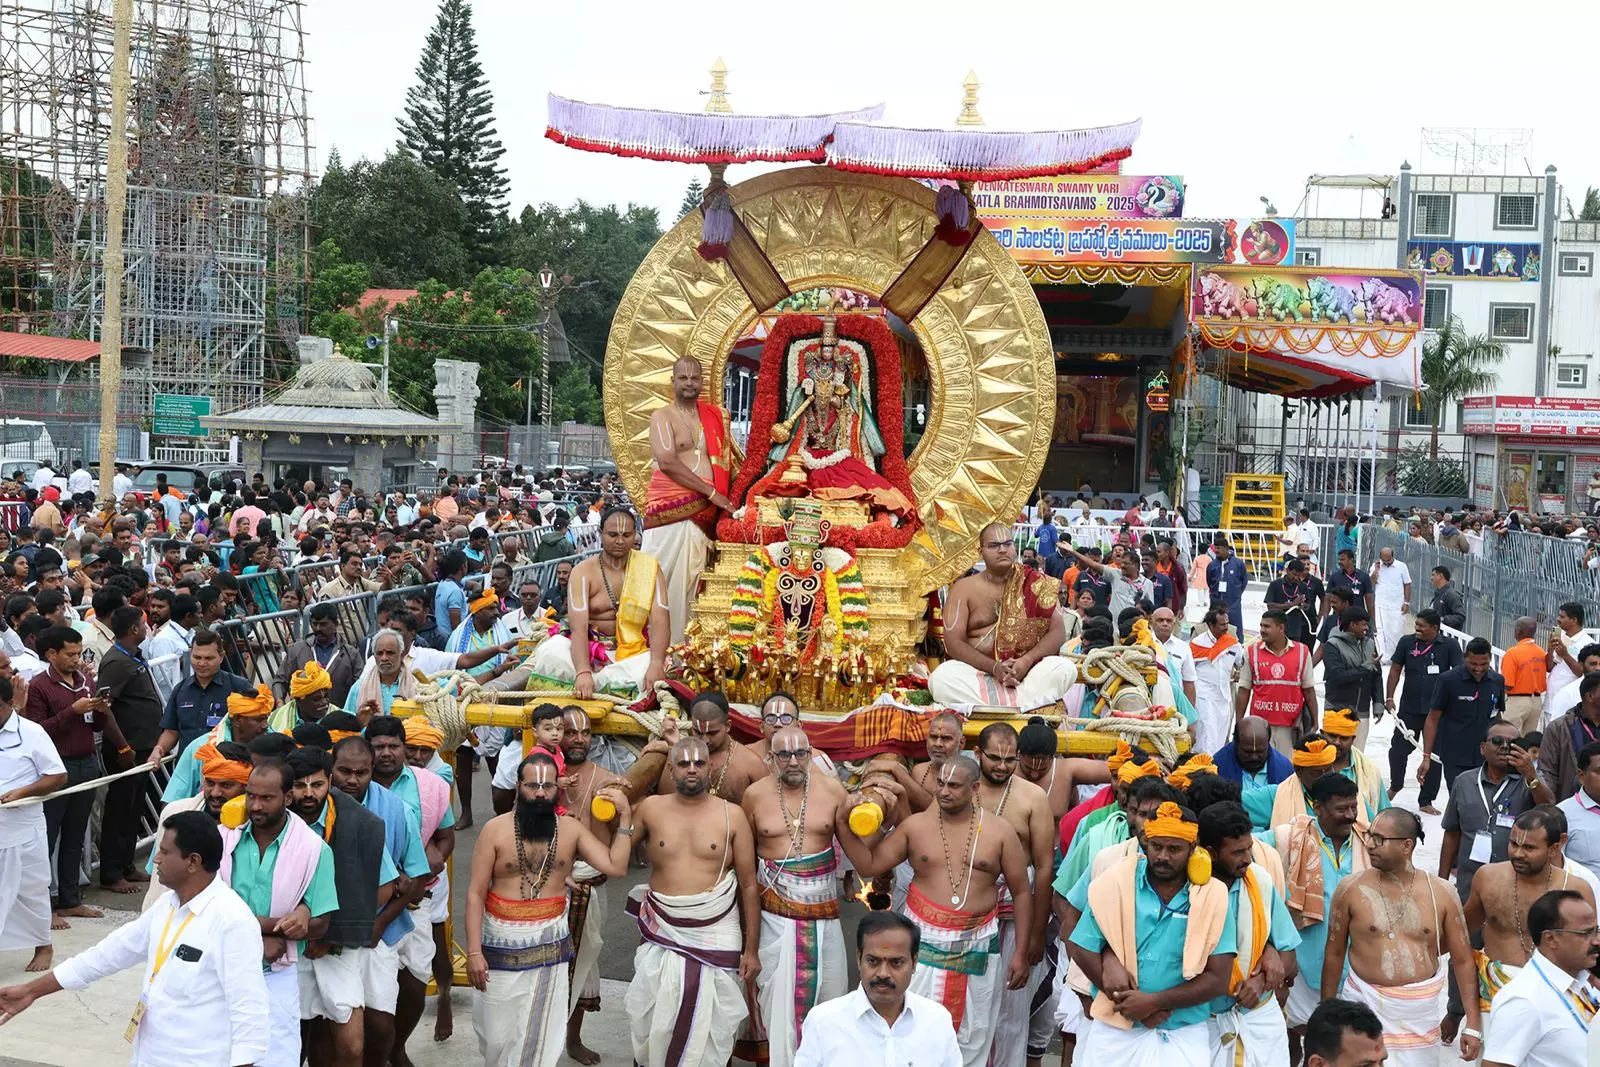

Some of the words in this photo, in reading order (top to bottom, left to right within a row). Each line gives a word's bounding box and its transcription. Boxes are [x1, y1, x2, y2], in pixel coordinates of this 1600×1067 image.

[977, 180, 1054, 193] VENKATESWARA
[1057, 182, 1094, 194] SWAMY
[1096, 183, 1120, 194] VARI
[1003, 195, 1097, 211] BRAHMOTSAVAMS
[1106, 196, 1135, 211] 2025
